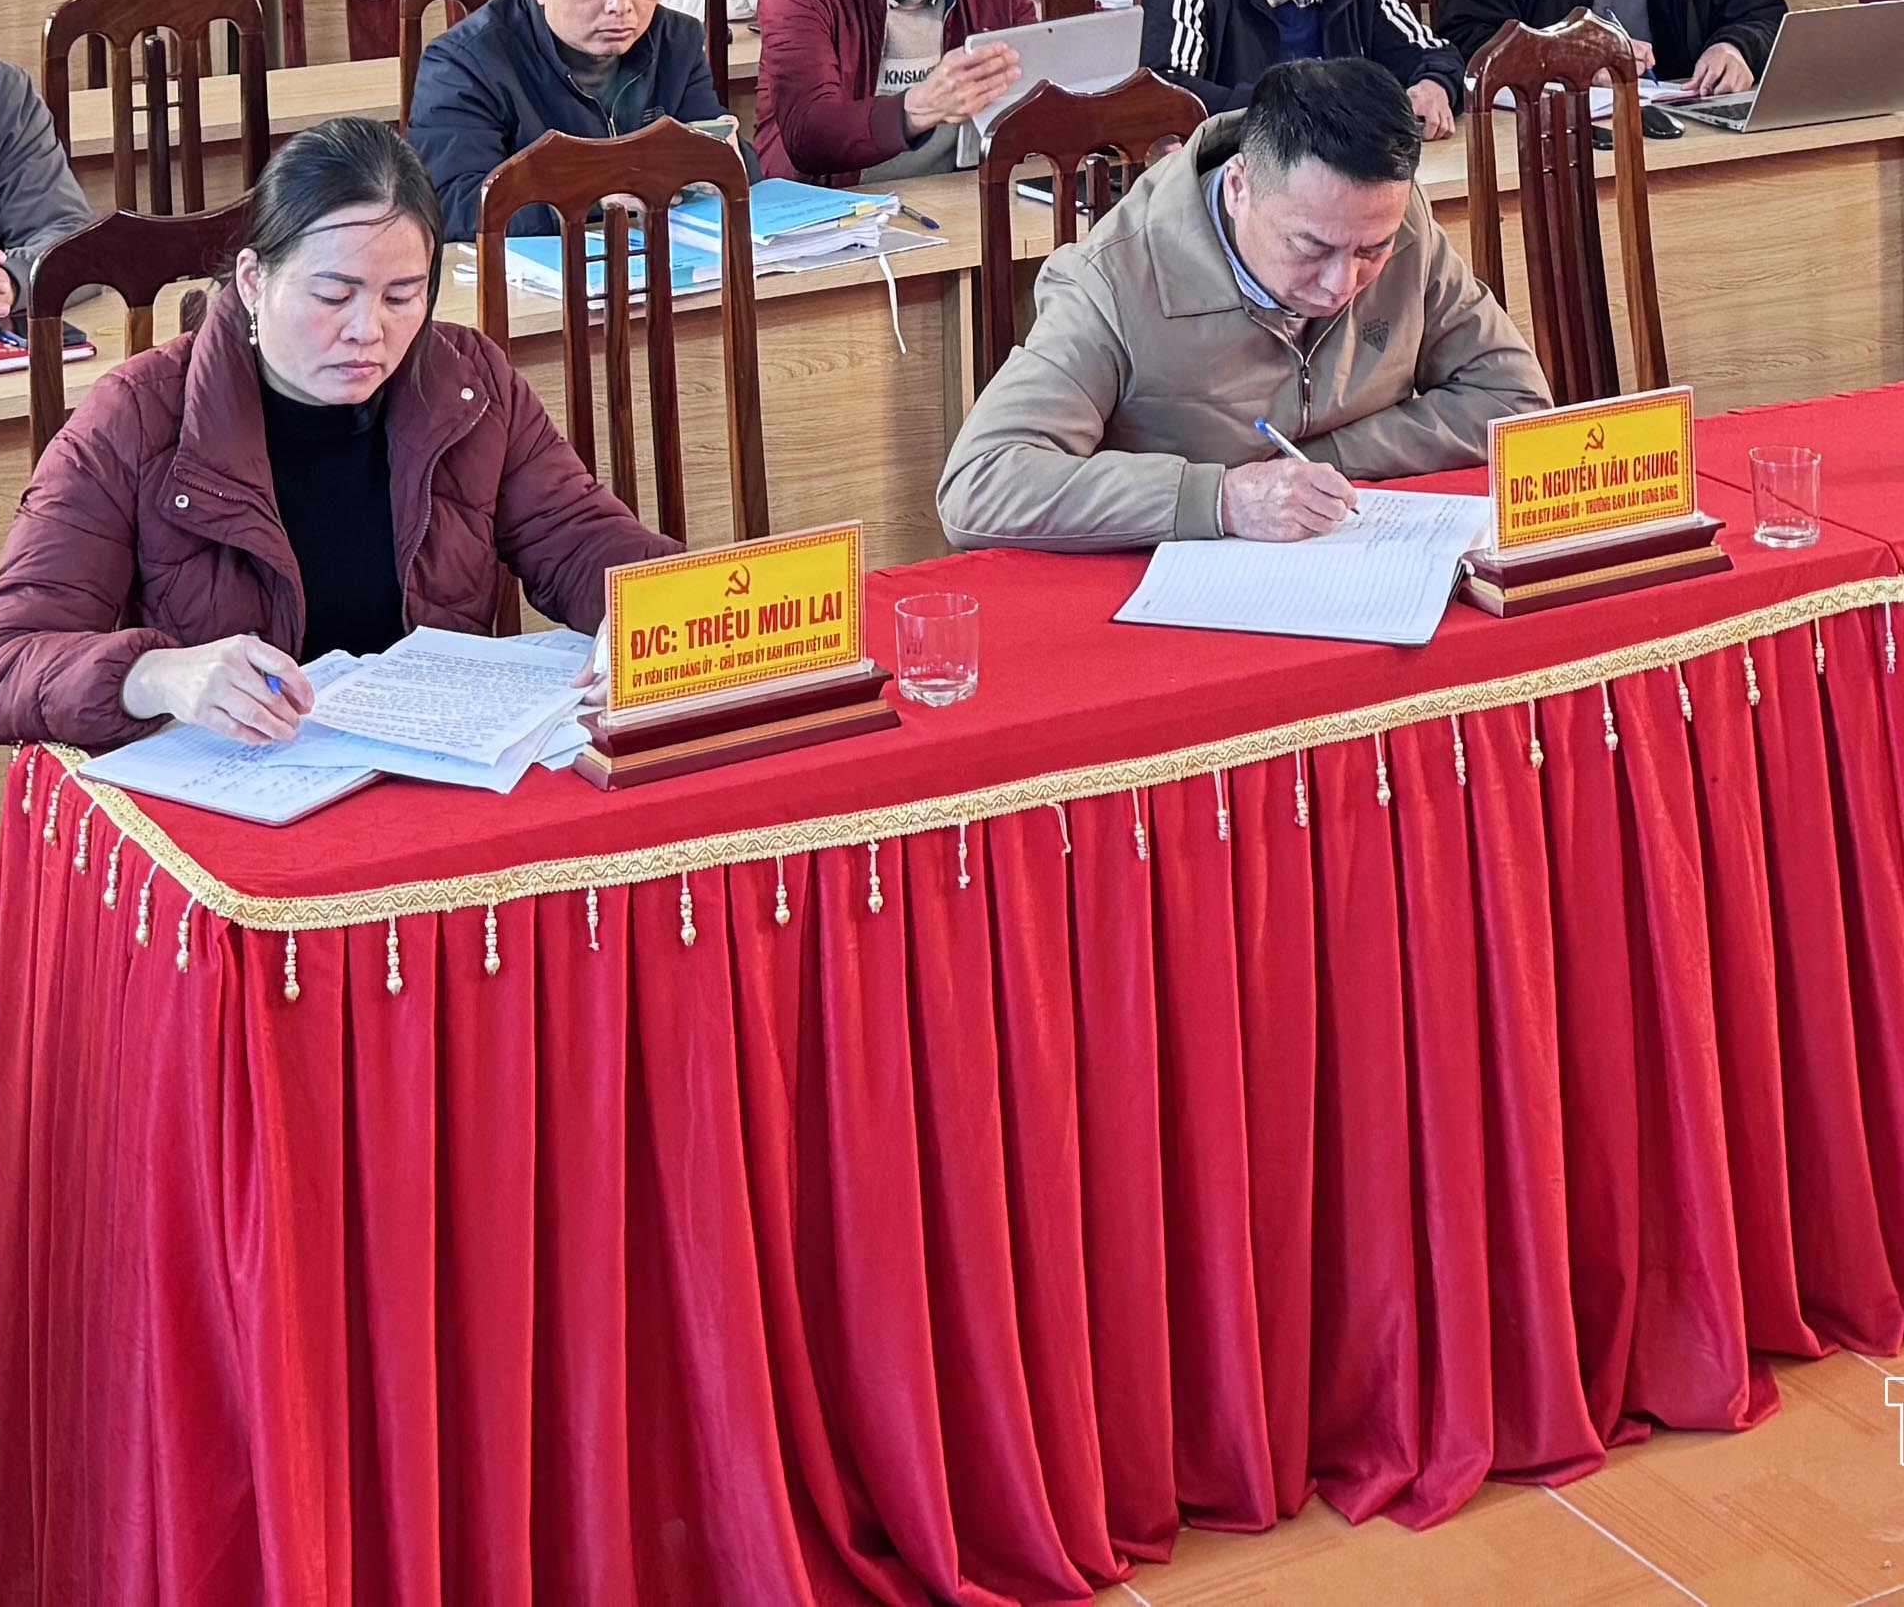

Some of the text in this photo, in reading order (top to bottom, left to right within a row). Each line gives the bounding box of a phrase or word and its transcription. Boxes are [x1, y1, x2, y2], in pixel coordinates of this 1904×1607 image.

[1510, 449, 1679, 505] Đ/C: NGUYỄN VĂN CHUNG
[630, 591, 842, 661] Đ/C: TRIỆU MÙI LAI
